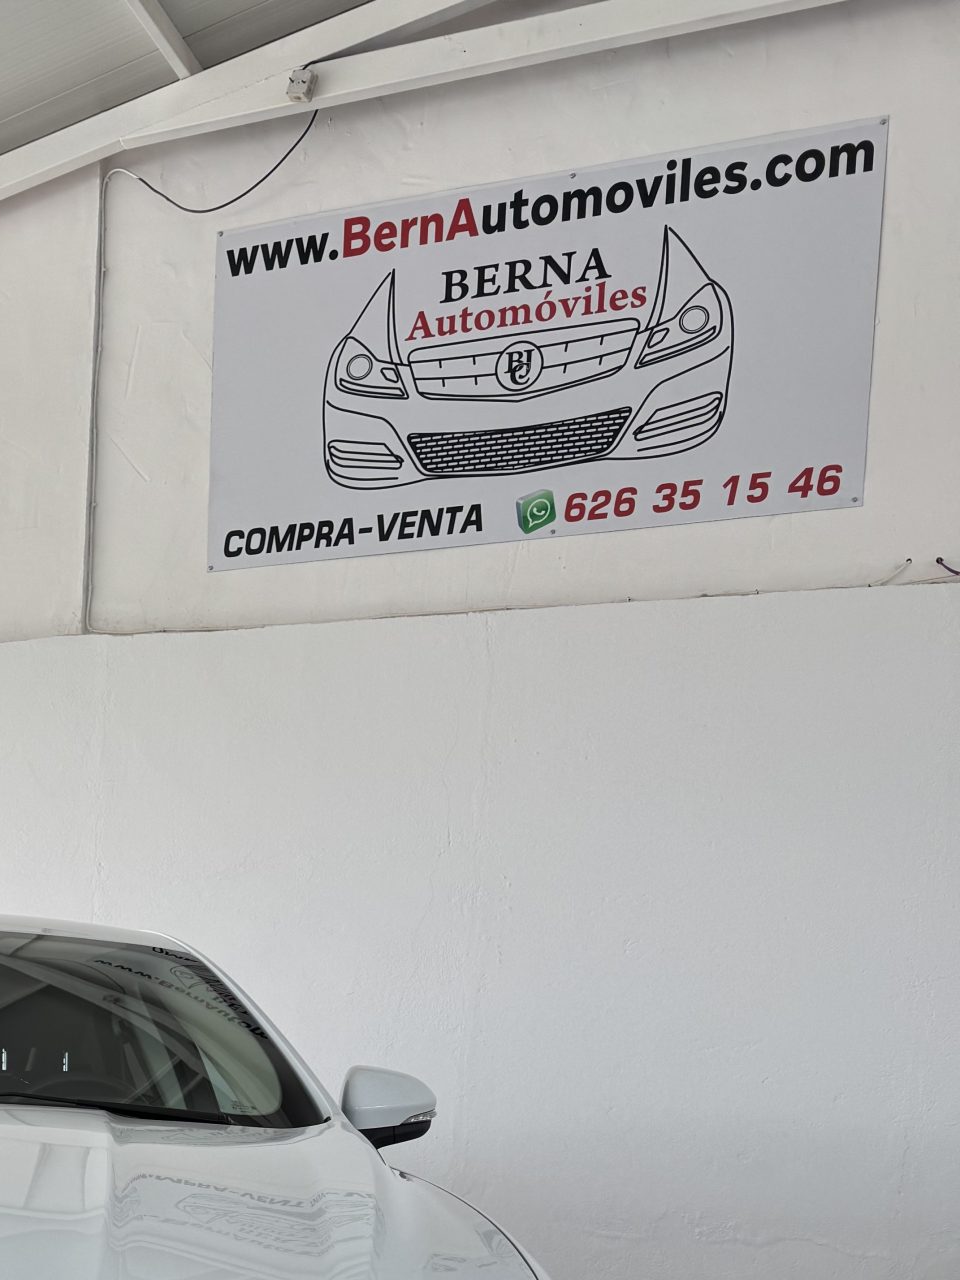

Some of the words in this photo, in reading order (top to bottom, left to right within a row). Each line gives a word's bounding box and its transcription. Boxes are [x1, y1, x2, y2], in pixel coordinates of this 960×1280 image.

[227, 139, 875, 277] www.BernAutomoviles.com
[440, 247, 613, 304] BERNA
[405, 281, 647, 341] Automóviles
[564, 487, 637, 522] 626
[652, 479, 703, 513] 35
[722, 471, 772, 506] 15
[788, 464, 843, 498] 46
[224, 503, 483, 558] COMPRA-VENTA
